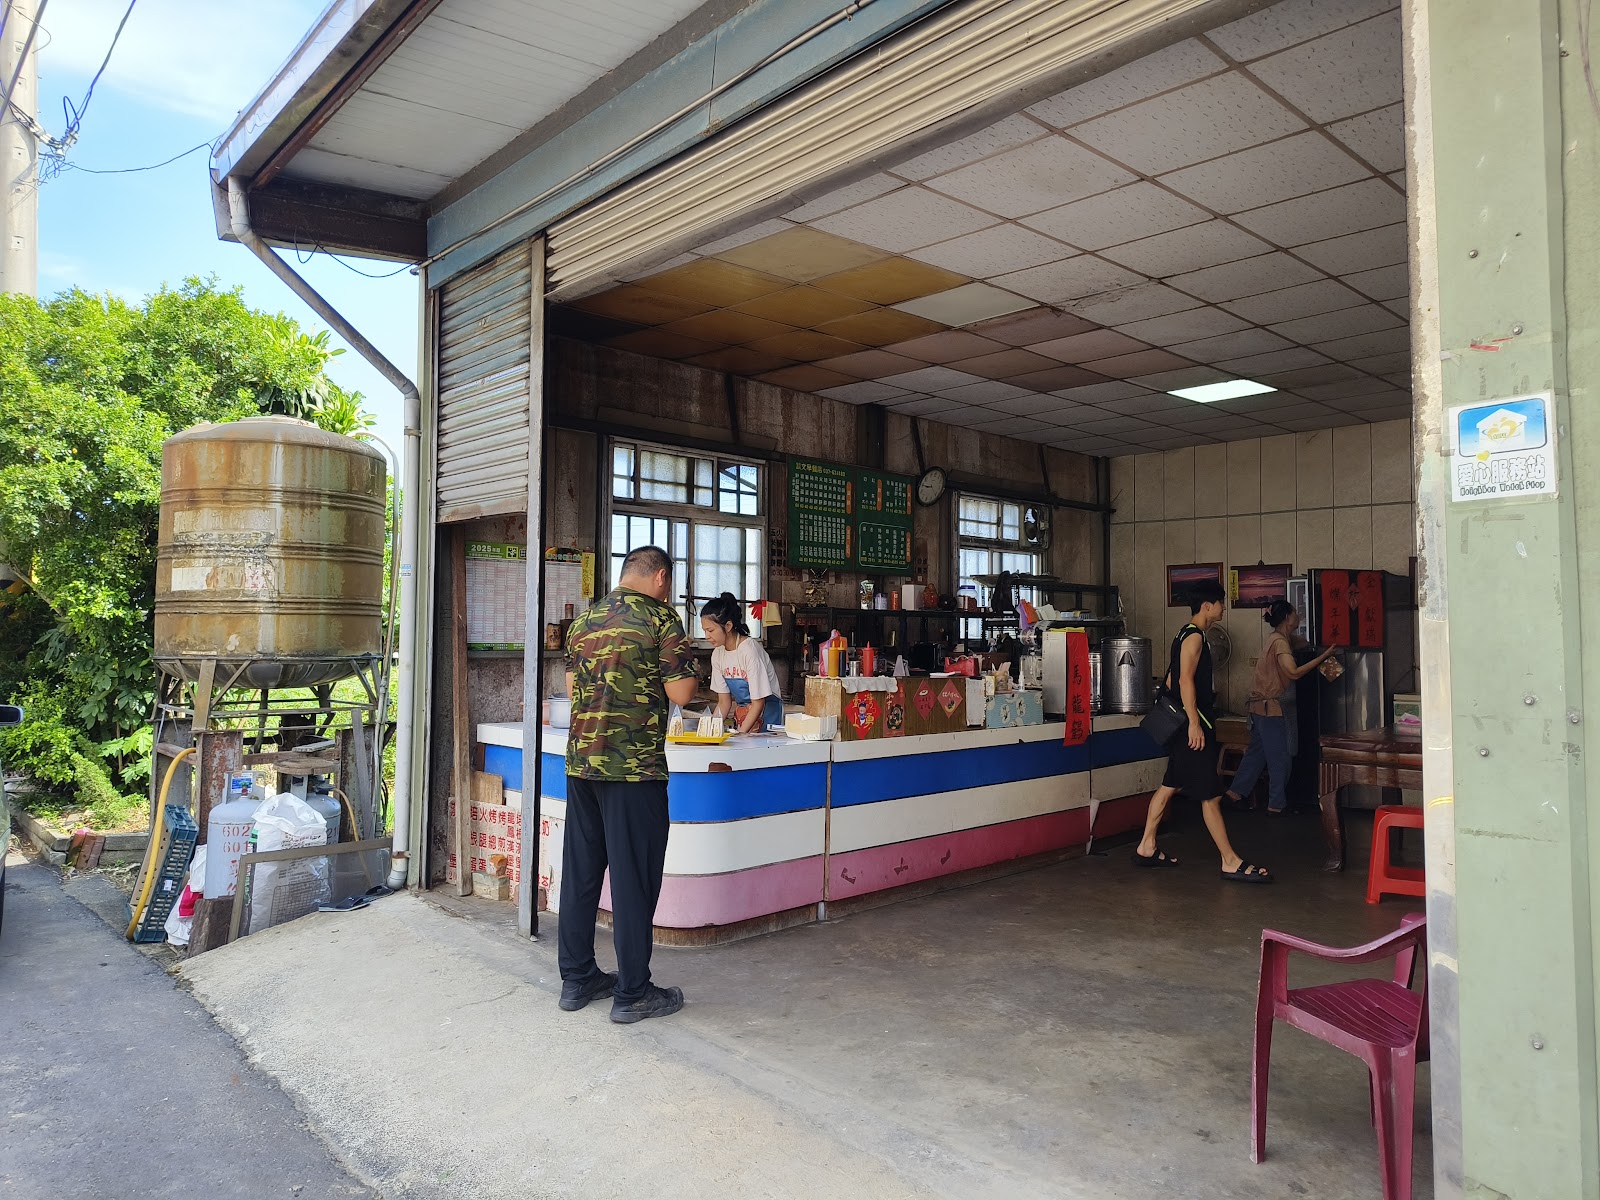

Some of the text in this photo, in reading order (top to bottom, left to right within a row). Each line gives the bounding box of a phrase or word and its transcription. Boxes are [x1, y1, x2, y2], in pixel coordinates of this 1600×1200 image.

[1458, 454, 1545, 487] 愛心服務站
